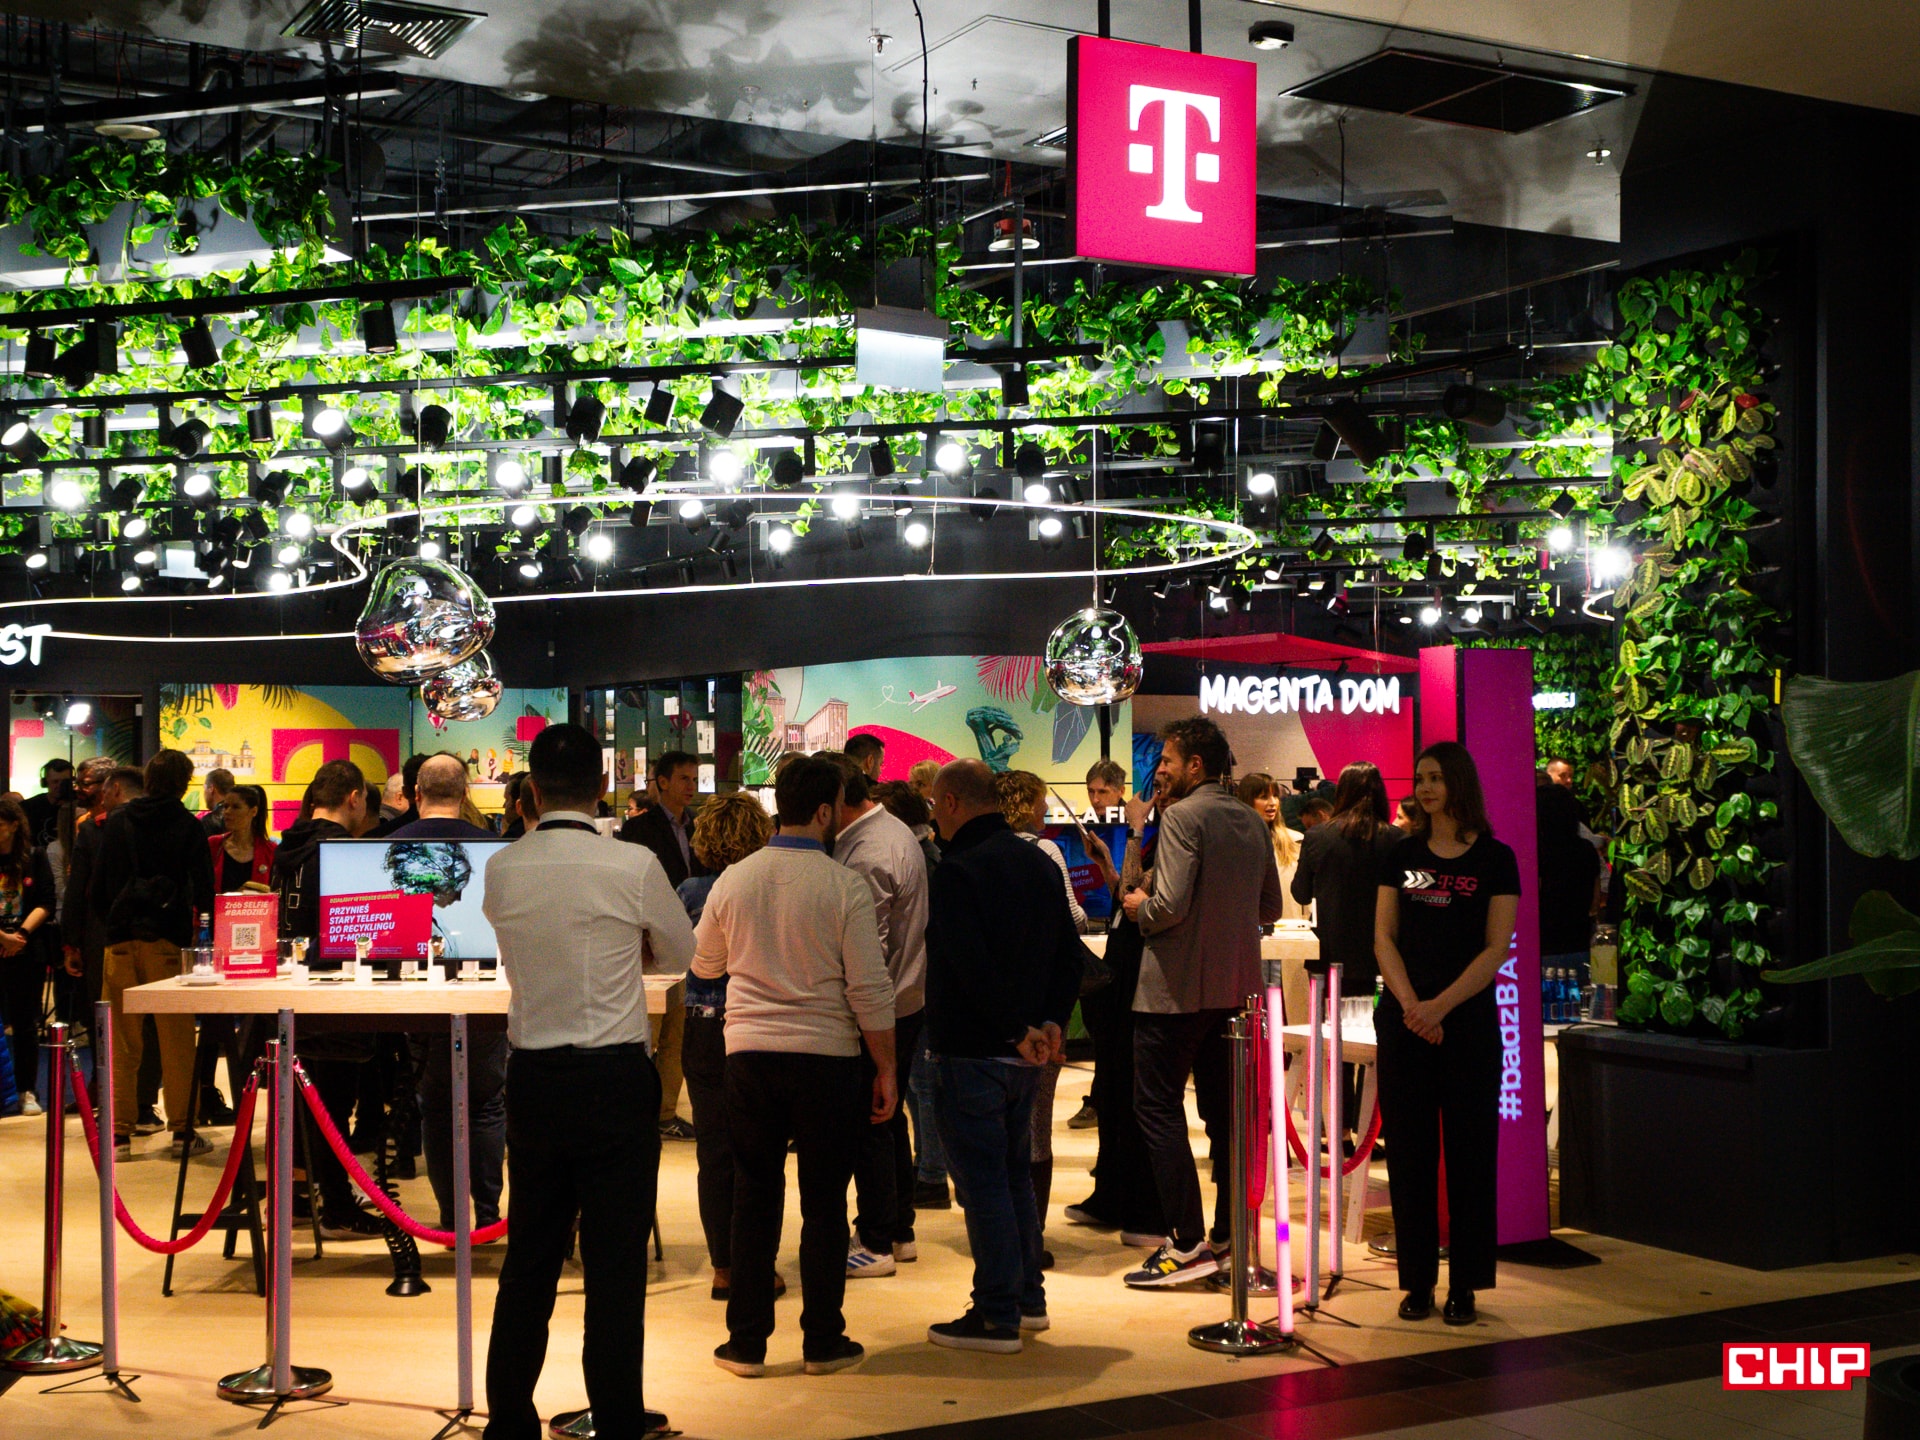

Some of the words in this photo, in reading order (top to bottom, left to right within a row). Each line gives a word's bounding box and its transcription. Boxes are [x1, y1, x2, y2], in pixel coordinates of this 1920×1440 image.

[1129, 84, 1221, 224] T
[1199, 673, 1334, 715] MAGENTA
[1338, 675, 1400, 715] DOM
[1454, 876, 1478, 892] 5G
[243, 901, 269, 909] SELFIE
[329, 903, 370, 916] PRZYNIEŚ
[224, 908, 269, 917] #BARDZIEJ
[329, 915, 355, 925] STARY
[356, 912, 392, 923] TELEFON
[329, 925, 342, 934] DO
[343, 921, 395, 933] RECYKLINGU
[329, 935, 339, 943] W
